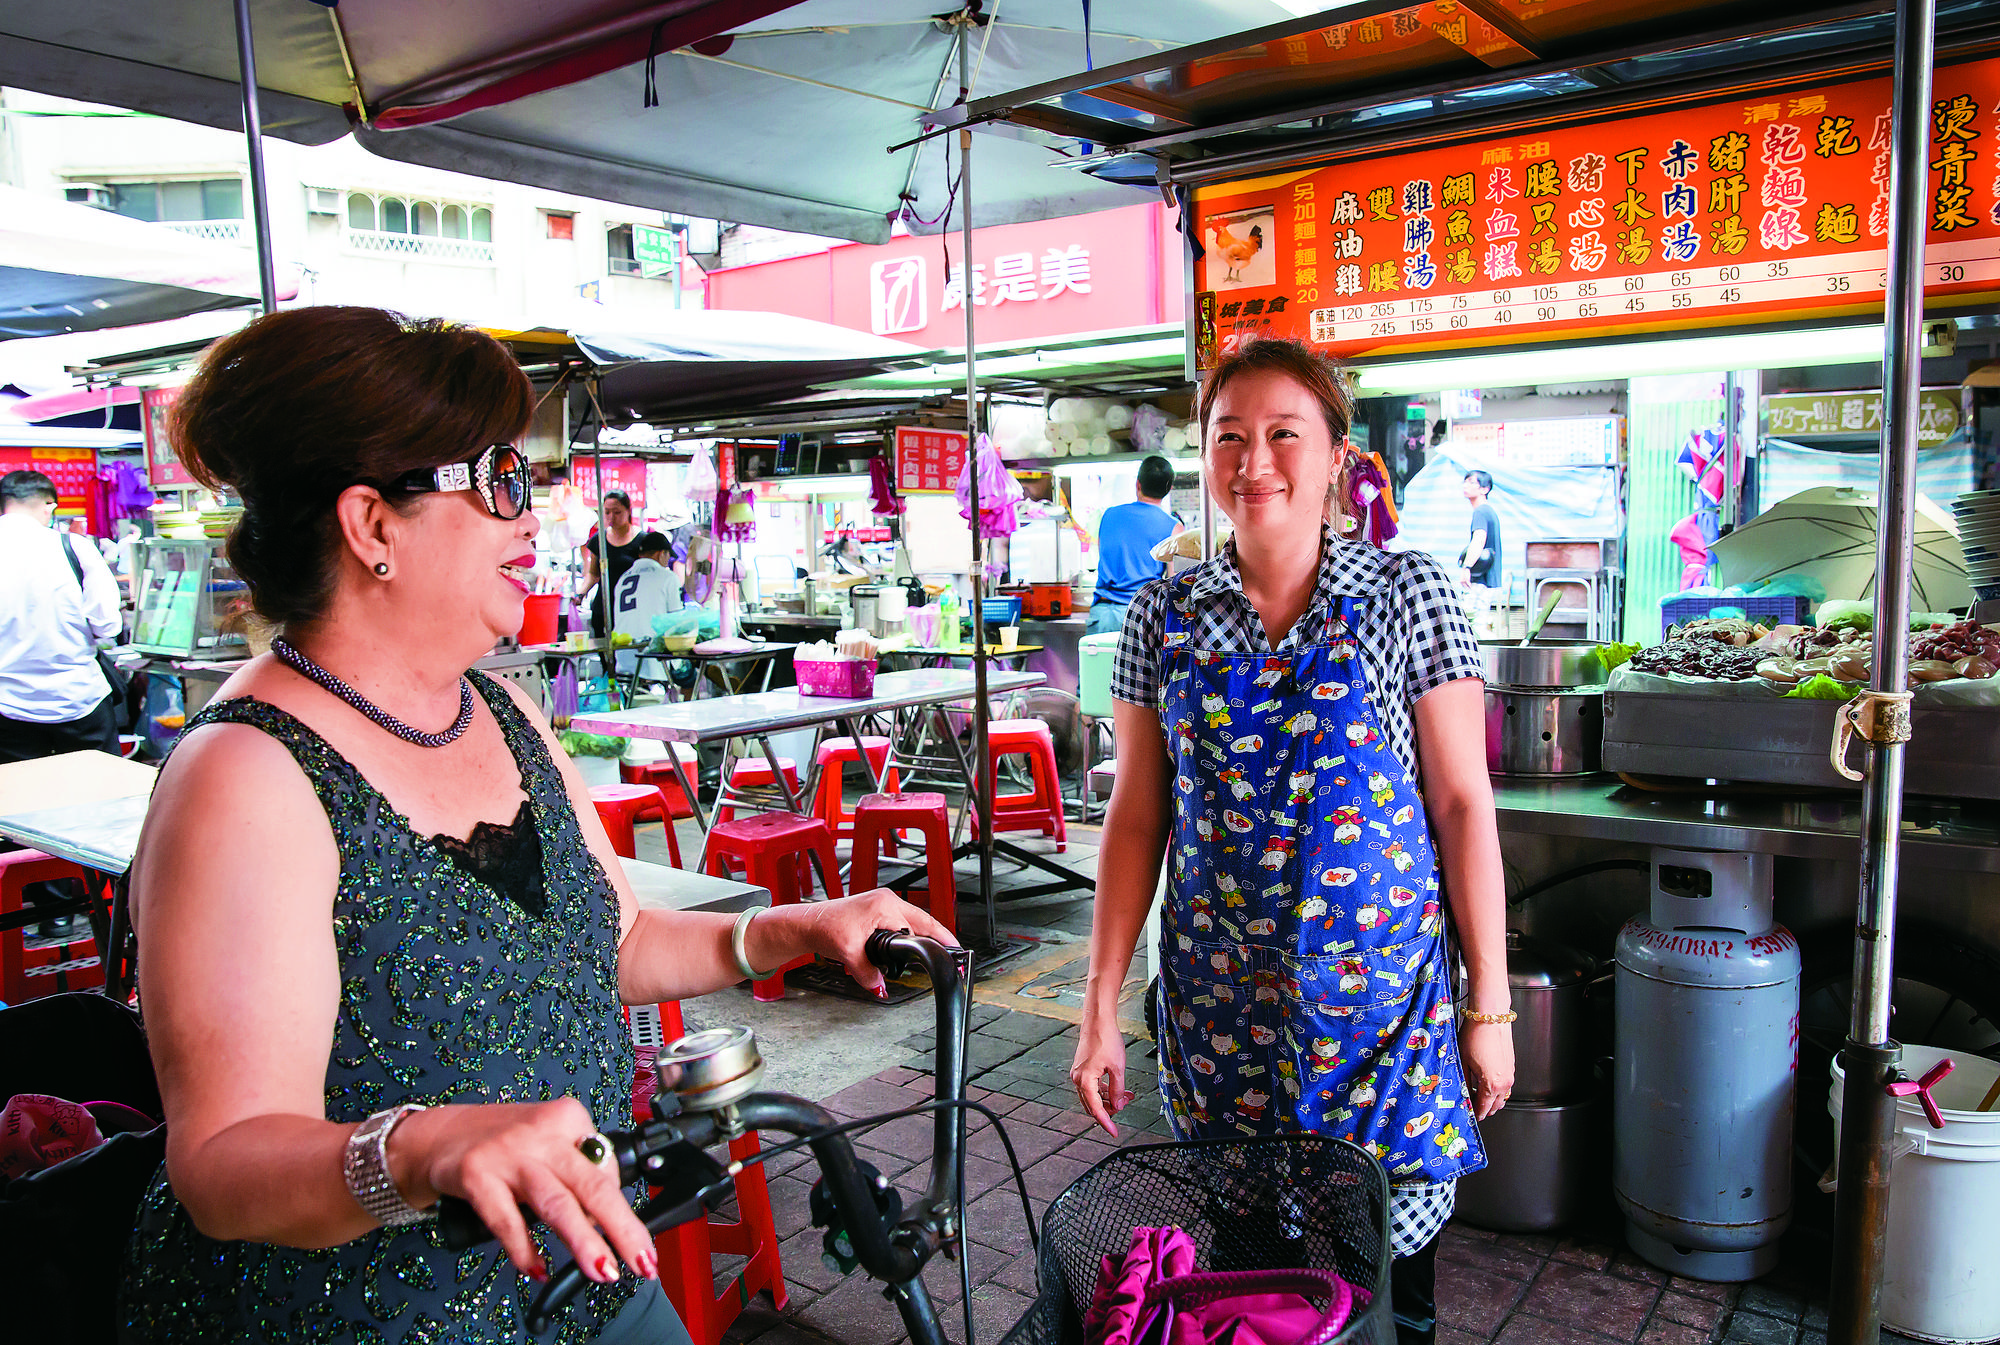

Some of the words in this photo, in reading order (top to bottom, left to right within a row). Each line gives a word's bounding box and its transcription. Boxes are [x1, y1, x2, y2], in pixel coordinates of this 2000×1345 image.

[1481, 141, 1550, 166] 麻油
[1742, 95, 1828, 125] 清湯
[1931, 94, 1981, 232] 燙青菜
[1441, 173, 1477, 285] 鯛魚湯
[1484, 167, 1522, 281] 米血糕
[1524, 160, 1563, 276] 腰只湯
[1567, 153, 1607, 272] 豬心湯
[1613, 148, 1655, 265] 下水湯
[1660, 139, 1700, 262] 赤肉湯
[1708, 131, 1750, 257] 豬肝湯
[1759, 124, 1809, 250] 乾麵線
[941, 244, 1091, 312] 康是美
[1315, 309, 1336, 325] 麻油
[1340, 306, 1363, 321] 120
[1369, 302, 1395, 317] 265
[1409, 299, 1433, 313] 175
[1450, 296, 1467, 309] 75
[1493, 290, 1512, 304] 60
[1532, 287, 1559, 301] 105
[1578, 282, 1597, 297] 85
[1624, 277, 1645, 291] 60
[1671, 272, 1692, 287] 65
[1719, 266, 1741, 281] 60
[1767, 262, 1789, 277] 35
[1331, 192, 1364, 298] 麻油雞
[1316, 326, 1337, 341] 清湯
[1370, 322, 1396, 337] 245
[1409, 317, 1434, 332] 155
[1450, 314, 1468, 328] 60
[1493, 310, 1513, 324] 40
[1537, 306, 1557, 320] 90
[1578, 302, 1598, 317] 65
[1625, 297, 1645, 312] 45
[1671, 293, 1692, 307] 55
[1720, 287, 1741, 303] 45
[1827, 277, 1850, 292] 35
[1940, 265, 1964, 281] 30
[620, 574, 640, 612] 2
[1315, 757, 1326, 767] TAI
[1324, 757, 1344, 769] SHING
[1277, 818, 1296, 826] SHING
[1325, 942, 1336, 951] TAI
[1334, 941, 1354, 952] SHING
